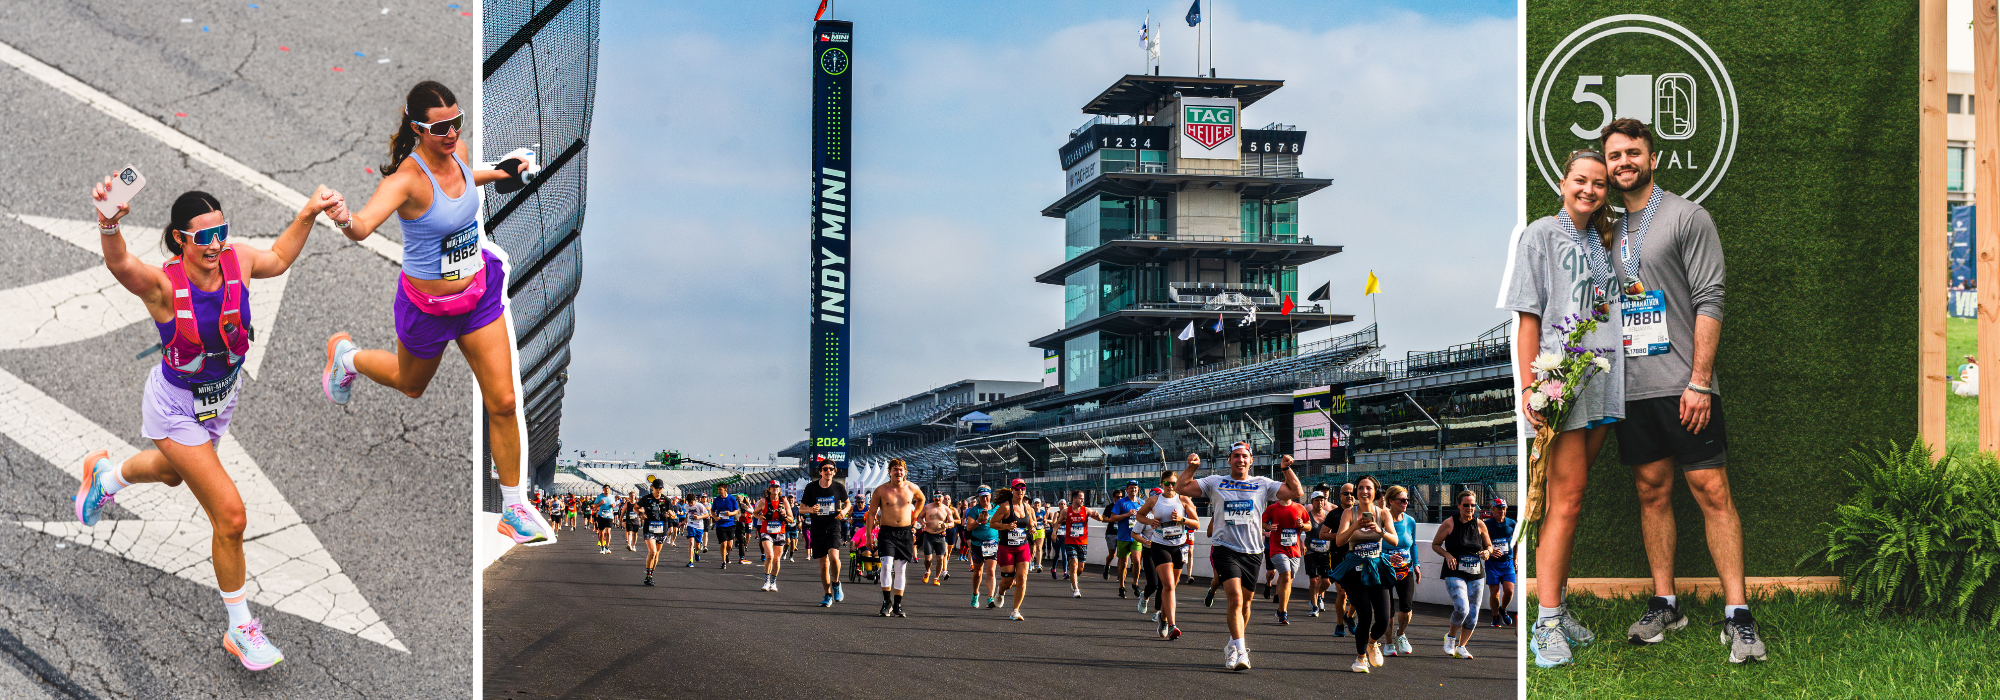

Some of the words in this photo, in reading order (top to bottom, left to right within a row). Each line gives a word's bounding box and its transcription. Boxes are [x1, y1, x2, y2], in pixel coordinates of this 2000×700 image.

[1189, 109, 1230, 123] TAG
[1188, 125, 1231, 146] HEUER
[1102, 137, 1108, 147] 1
[1115, 137, 1123, 148] 2
[1130, 137, 1137, 148] 3
[1143, 138, 1151, 149] 4
[1250, 142, 1257, 152] 5
[1264, 142, 1271, 152] 6
[1278, 143, 1285, 153] 7
[1292, 143, 1299, 153] 8
[821, 166, 846, 241] MINI
[821, 246, 846, 325] INDY
[1621, 310, 1662, 328] 17880
[816, 437, 846, 447] 2024
[1228, 508, 1251, 517] 17472
